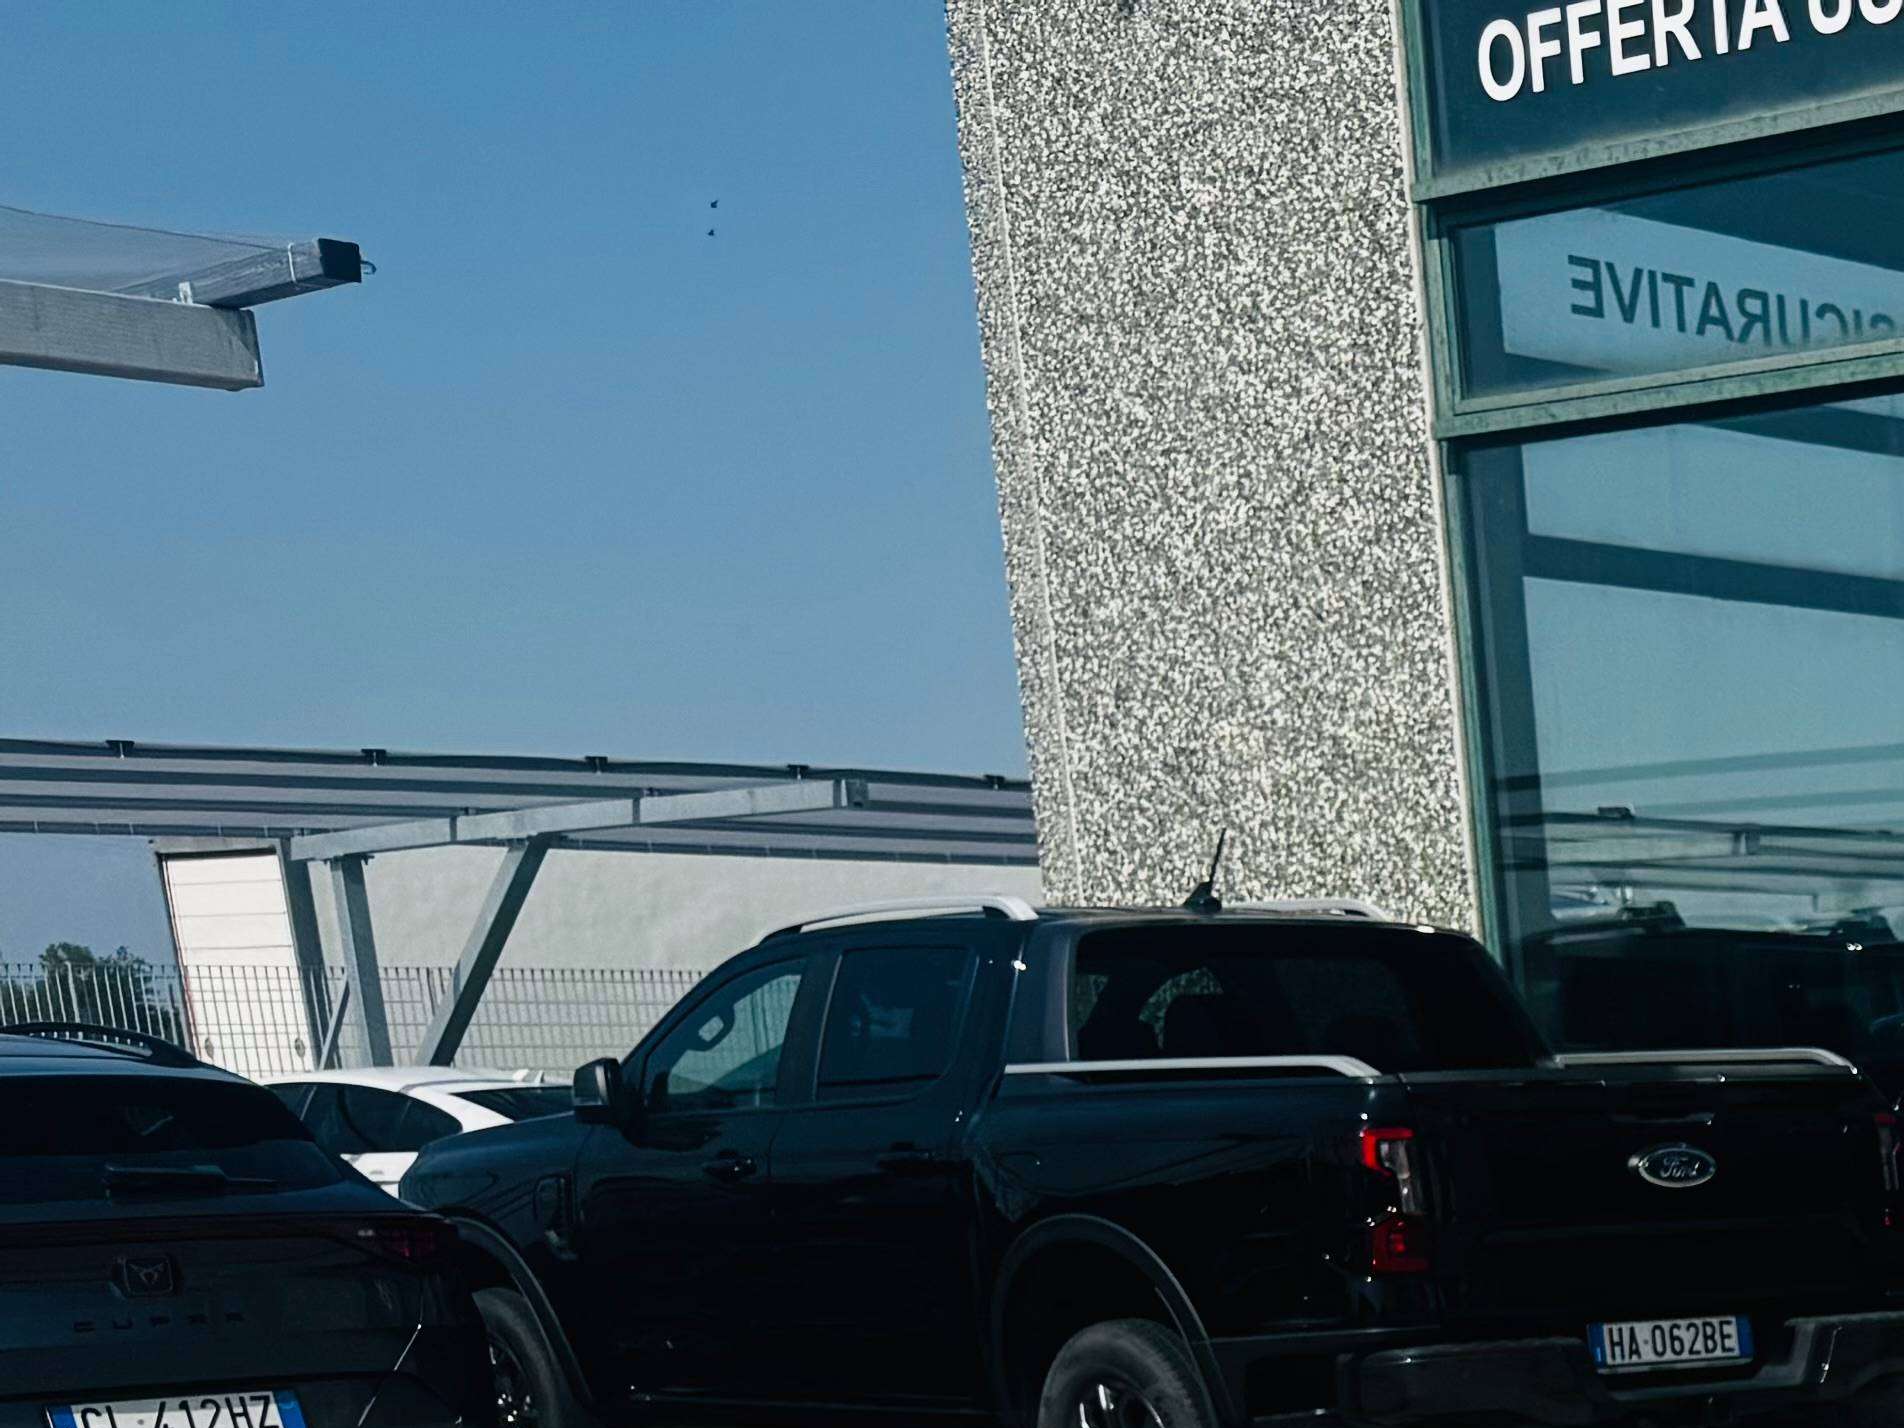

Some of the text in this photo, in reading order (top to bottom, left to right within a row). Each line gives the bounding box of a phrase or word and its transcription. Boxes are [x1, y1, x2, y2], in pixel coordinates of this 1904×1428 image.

[1478, 0, 1790, 101] OFFERTA
[1608, 1326, 1642, 1361] HA
[1651, 1320, 1735, 1357] 062BE
